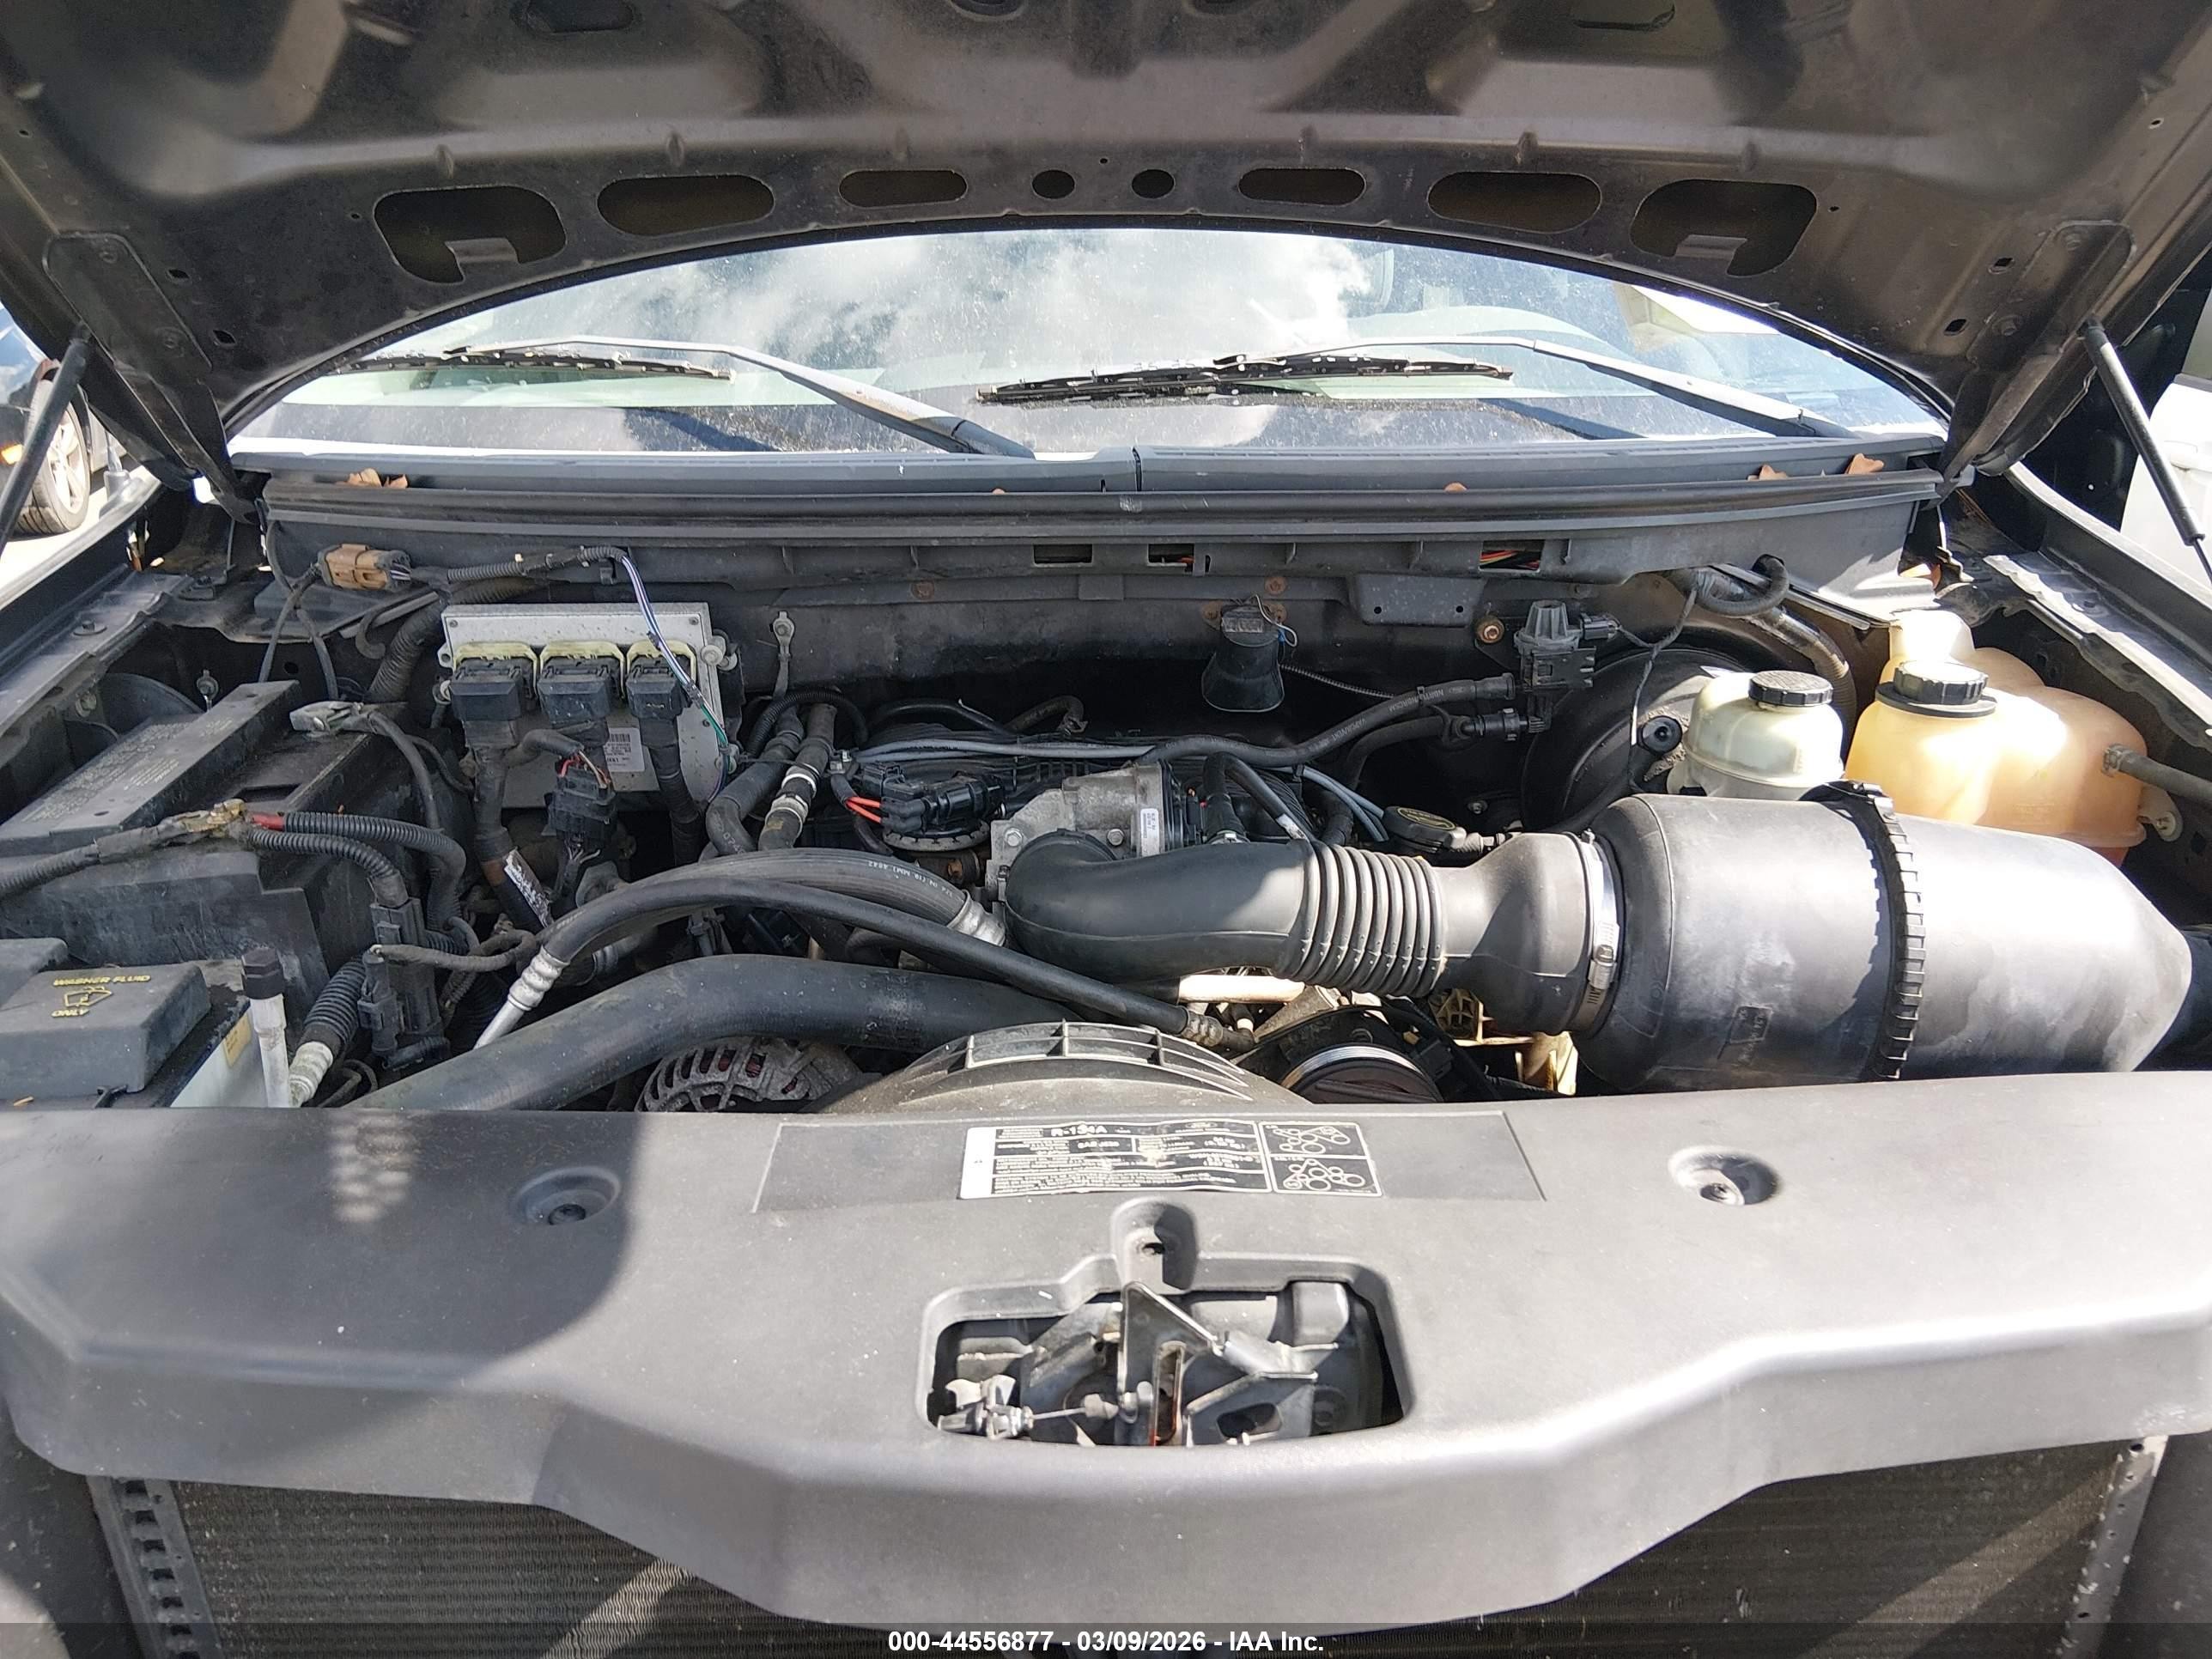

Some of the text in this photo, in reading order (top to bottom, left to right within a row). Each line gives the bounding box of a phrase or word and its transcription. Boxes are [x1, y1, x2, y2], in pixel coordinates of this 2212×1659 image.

[53, 975, 151, 987] WASHER FLUID
[52, 1008, 89, 1018] ONLY
[1050, 1123, 1108, 1137] R-134A
